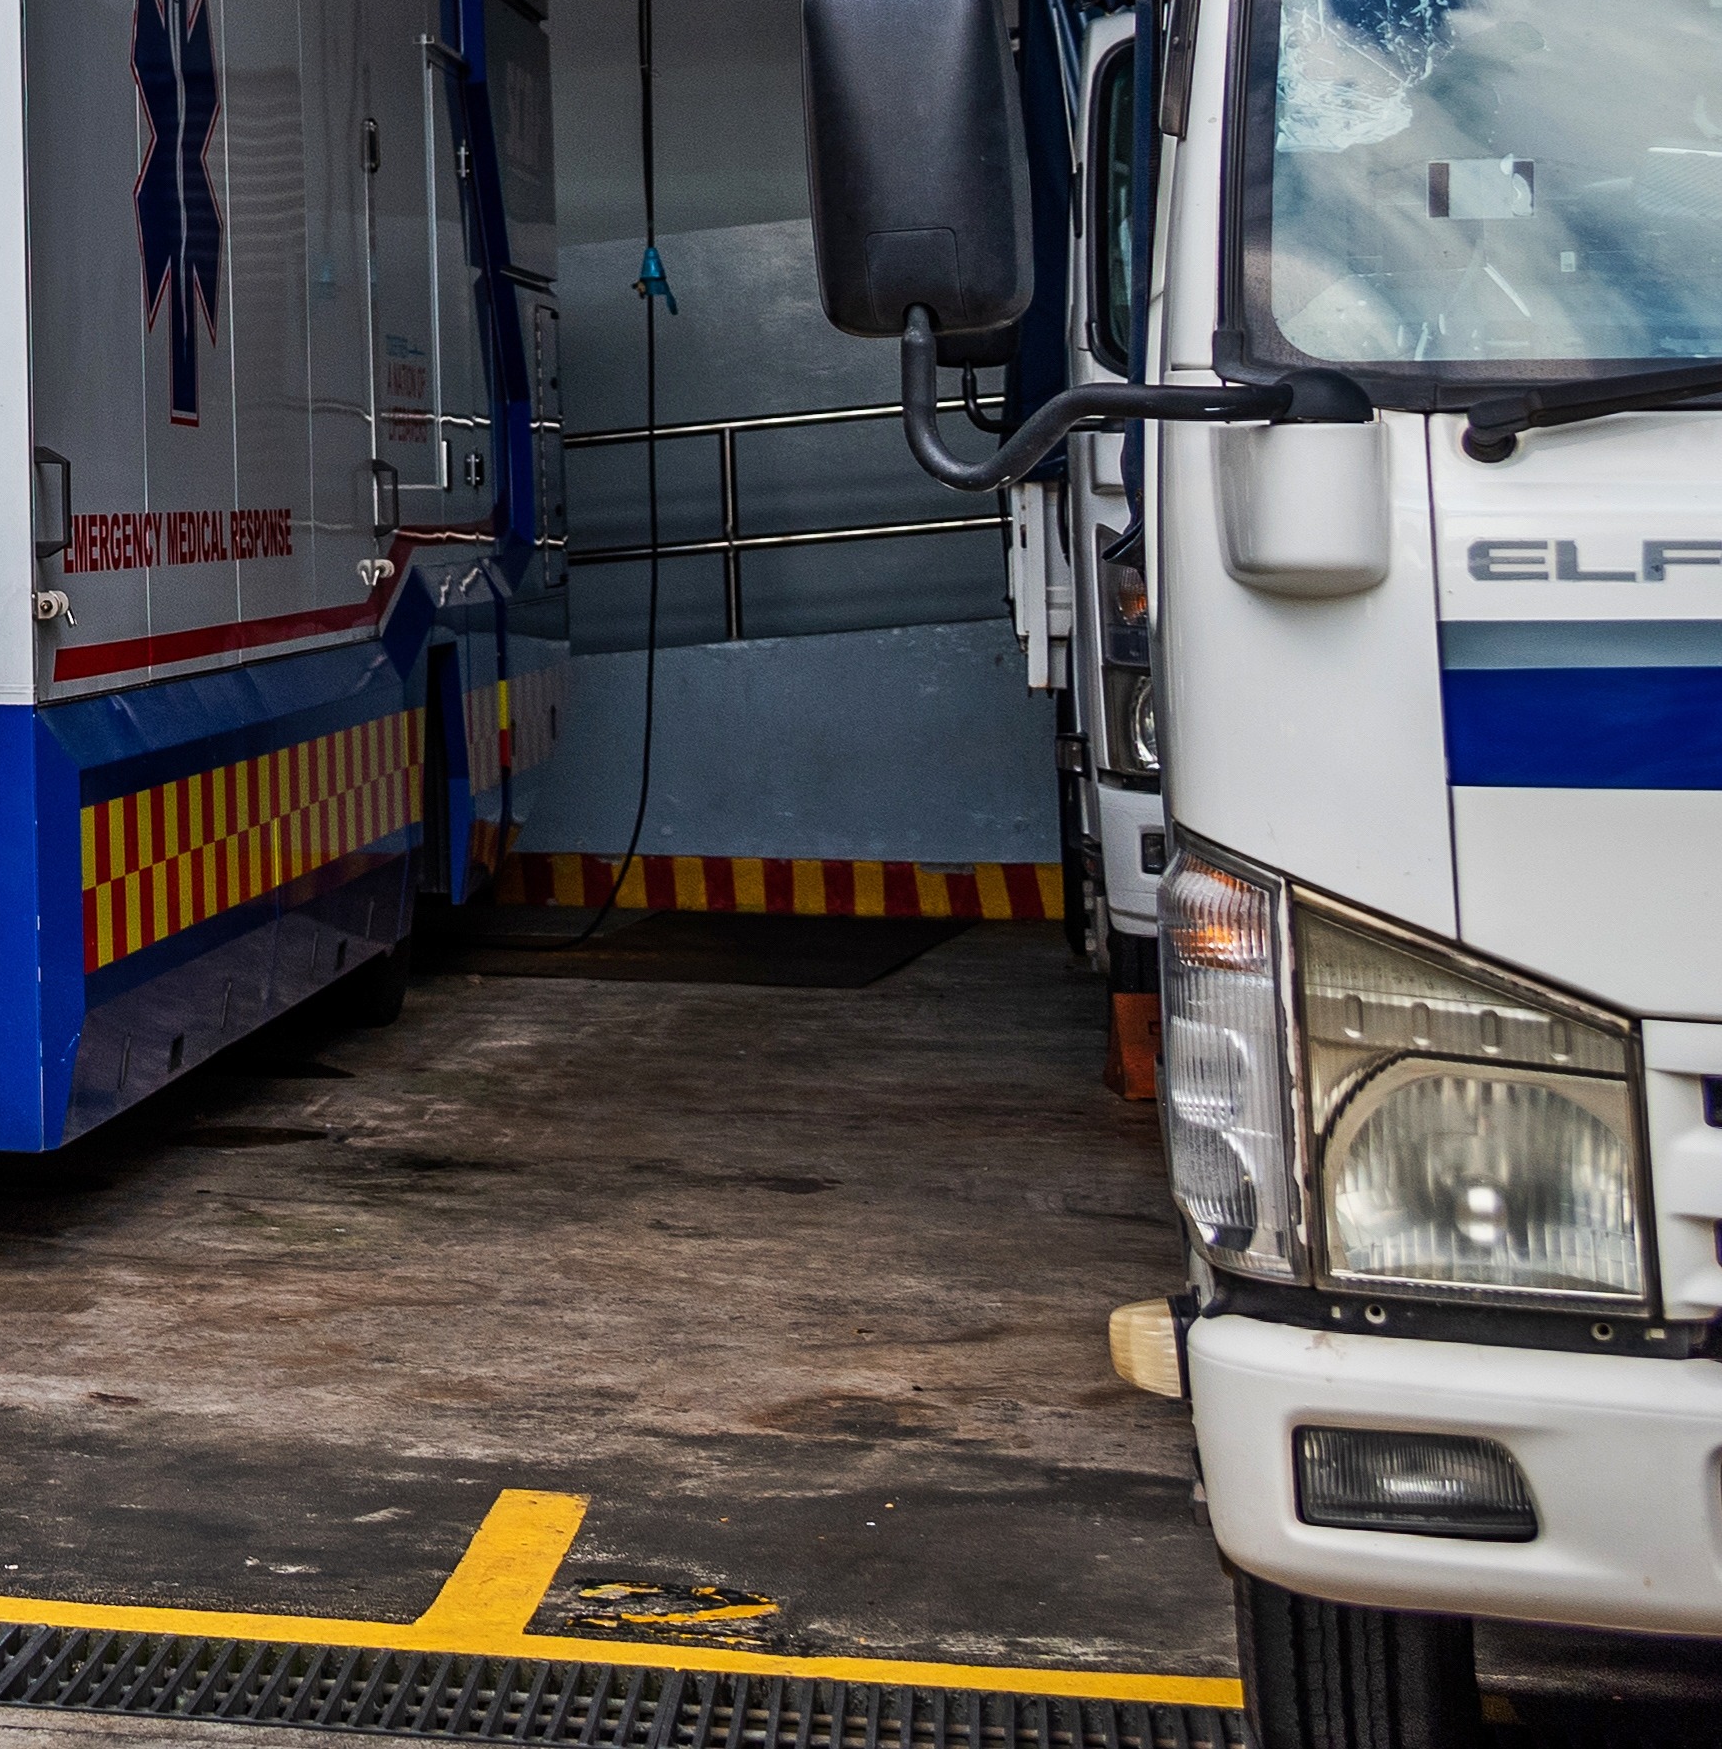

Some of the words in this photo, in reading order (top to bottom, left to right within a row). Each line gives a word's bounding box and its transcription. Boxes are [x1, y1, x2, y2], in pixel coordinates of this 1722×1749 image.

[166, 509, 228, 566] MEDICAL
[229, 508, 293, 560] RESPONSE
[1467, 539, 1722, 582] ELF
